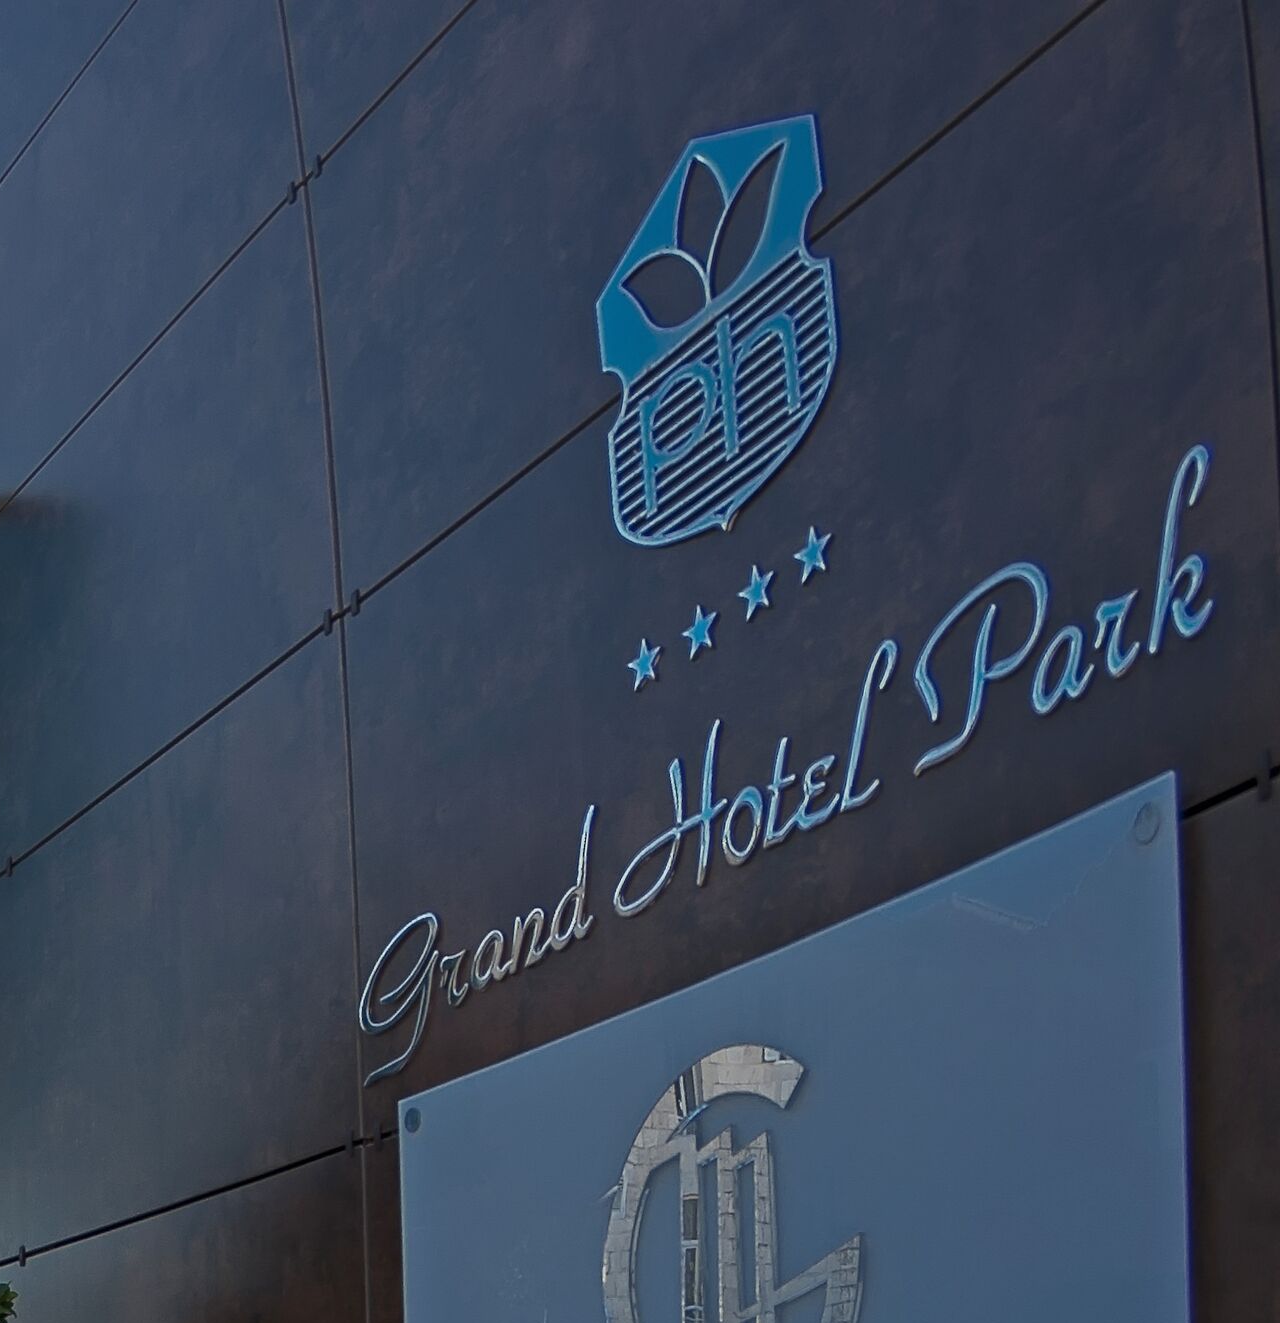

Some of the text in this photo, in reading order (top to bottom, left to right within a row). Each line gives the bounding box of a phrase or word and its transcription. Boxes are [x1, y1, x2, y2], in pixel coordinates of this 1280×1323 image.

[358, 444, 1214, 1087] Grand Hotel Park
